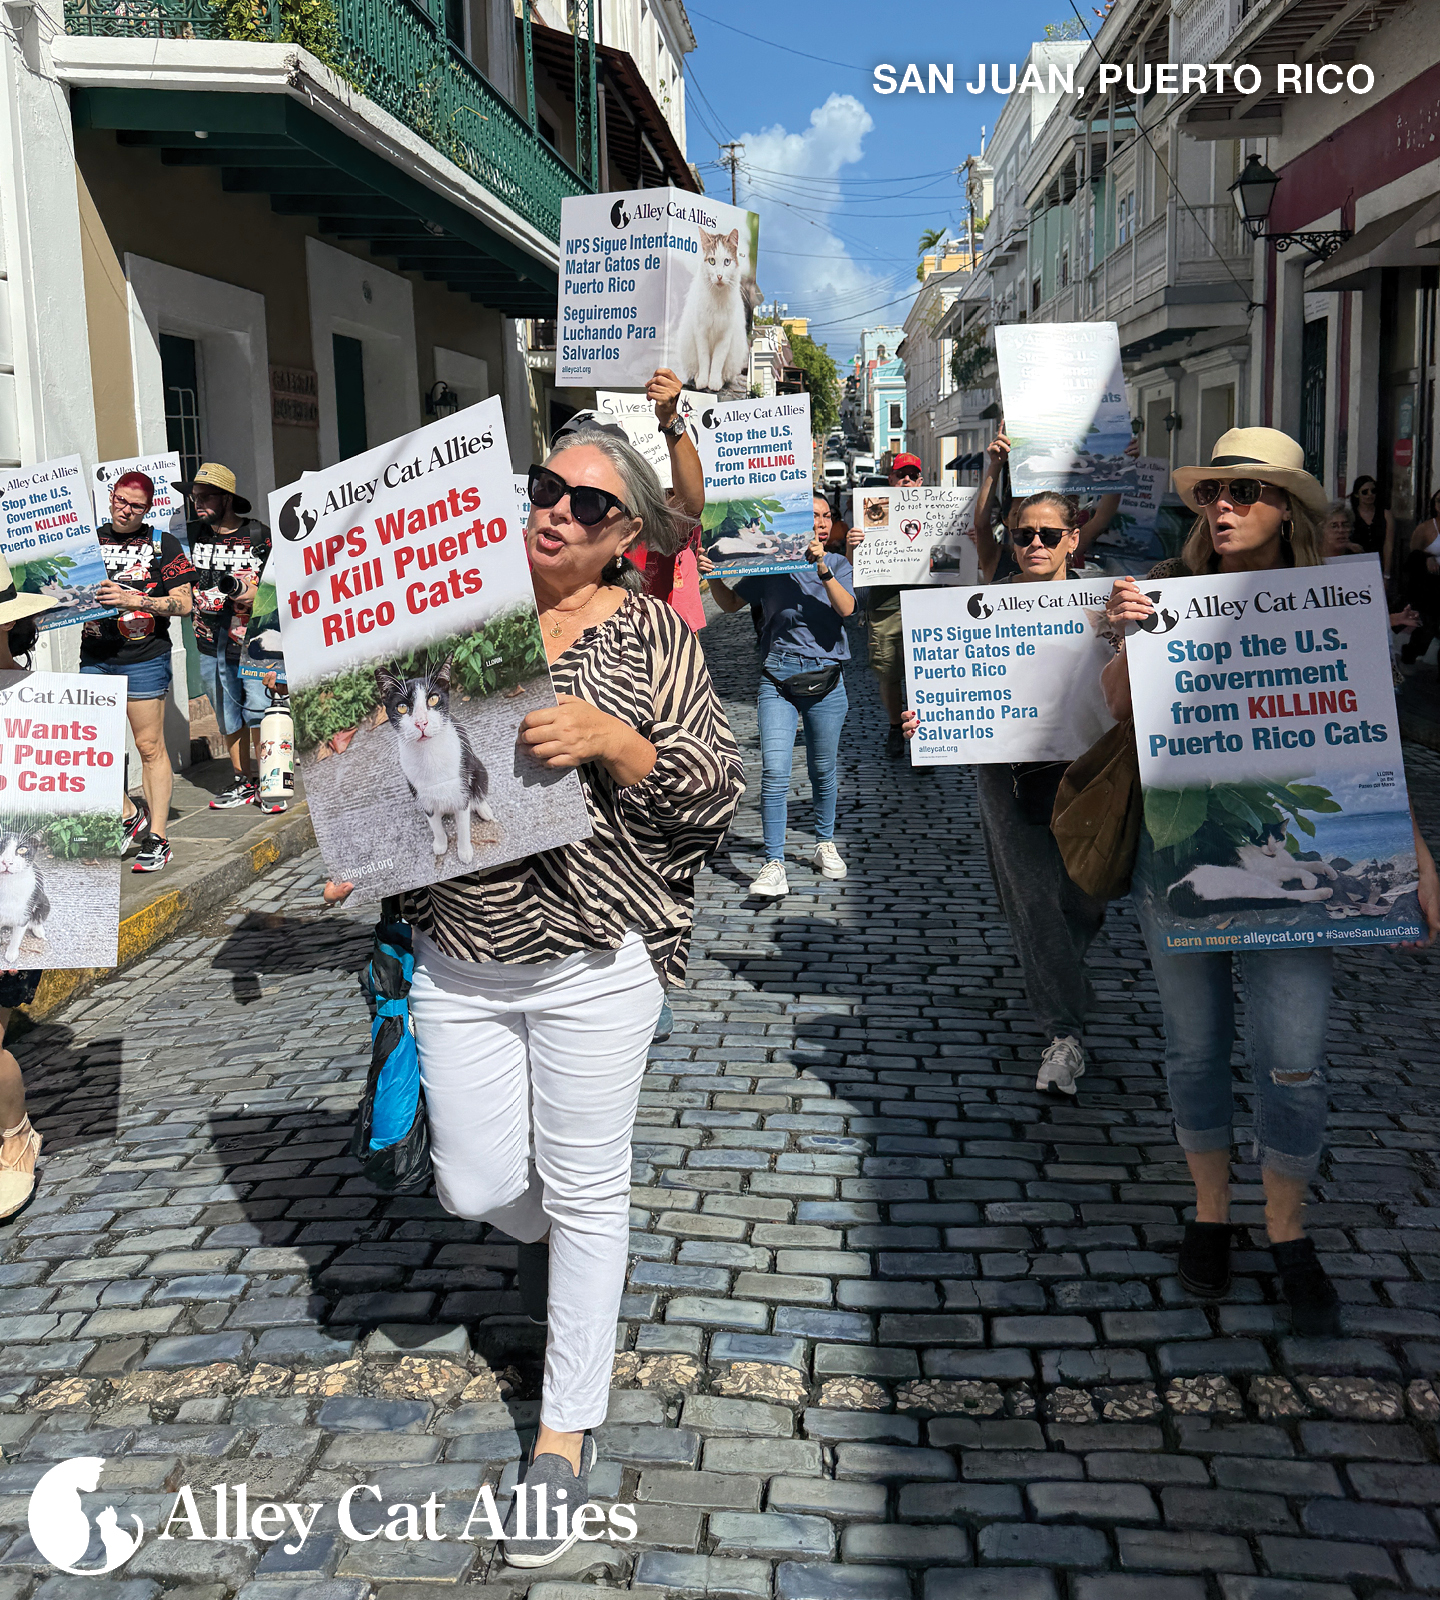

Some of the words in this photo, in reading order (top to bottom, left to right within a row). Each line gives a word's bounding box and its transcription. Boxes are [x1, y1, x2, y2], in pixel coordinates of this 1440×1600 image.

[633, 203, 664, 221] Alley
[666, 201, 687, 221] Cat
[687, 208, 717, 228] Allies
[566, 238, 590, 255] NPS
[592, 236, 627, 255] Sigue
[630, 232, 698, 254] Intentando
[565, 258, 600, 275] Matar
[605, 256, 640, 273] Gatos
[644, 254, 660, 270] de
[565, 279, 604, 295] Puerto
[608, 276, 636, 293] Rico
[563, 305, 638, 324] Seguiremos
[563, 324, 623, 341] Luchando
[627, 323, 656, 340] Para
[562, 345, 620, 361] Salvarlos
[561, 365, 592, 375] alleycat.org
[723, 410, 751, 423] Alley
[753, 408, 773, 419] Cat
[774, 404, 805, 417] Allies
[715, 431, 744, 444] Stop
[746, 428, 767, 440] the
[770, 425, 793, 438] U.S.
[717, 440, 793, 458] Government
[152, 460, 177, 471] Allies
[322, 478, 379, 516] Alley
[383, 457, 424, 489] Cat
[428, 430, 494, 473] Allies
[715, 461, 744, 473] from
[748, 454, 795, 470] KILLING
[7, 478, 31, 492] Alley
[32, 473, 50, 485] Cat
[51, 466, 79, 480] Allies
[704, 474, 745, 488] Puerto
[749, 472, 777, 484] Rico
[780, 468, 807, 481] Cats
[1, 497, 27, 512] Stop
[29, 493, 48, 505] the
[50, 485, 72, 499] U.S.
[894, 502, 906, 512] do
[6, 499, 74, 525] Government
[159, 507, 181, 517] Cats
[6, 525, 34, 539] from
[34, 511, 79, 532] KILLING
[302, 525, 368, 577] NPS
[374, 486, 481, 546] Wants
[0, 537, 36, 554] Puerto
[38, 531, 64, 545] Rico
[65, 524, 92, 538] Cats
[288, 589, 320, 620] to
[330, 556, 384, 604] Kill
[393, 517, 508, 580] Puerto
[738, 567, 770, 575] alleycat.org
[321, 601, 396, 648] Rico
[406, 567, 483, 616] Cats
[997, 596, 1035, 613] Alley
[1038, 594, 1065, 608] Cat
[1067, 592, 1110, 607] Allies
[1184, 595, 1248, 621] Alley
[1254, 590, 1298, 614] Cat
[1301, 585, 1372, 610] Allies
[911, 627, 943, 643] NPS
[946, 626, 992, 644] Sigue
[995, 620, 1084, 639] Intentando
[913, 646, 960, 662] Matar
[965, 643, 1011, 659] Gatos
[1015, 641, 1036, 656] de
[1167, 636, 1232, 665] Stop
[1240, 633, 1287, 658] the
[1295, 627, 1348, 654] U.S.
[241, 667, 258, 677] Learn
[914, 664, 966, 680] Puerto
[971, 662, 1007, 677] Rico
[1175, 659, 1349, 694] Government
[18, 686, 55, 704] Cat
[58, 688, 117, 707] Allies
[915, 688, 1012, 707] Seguiremos
[1170, 700, 1240, 725] from
[1247, 689, 1358, 720] KILLING
[916, 706, 996, 723] Luchando
[1001, 705, 1038, 719] Para
[4, 718, 98, 741] Wants
[918, 725, 994, 741] Salvarlos
[1148, 729, 1243, 758] Puerto
[1252, 725, 1316, 752] Rico
[1324, 719, 1388, 747] Cats
[14, 743, 114, 768] Puerto
[918, 745, 958, 754] alleycat.org
[18, 770, 86, 793] Cats
[341, 858, 394, 881] alleycat.org
[1166, 935, 1202, 948] Learn
[1206, 934, 1242, 946] more:
[1243, 930, 1315, 945] alleycat.org
[1326, 926, 1420, 939] #SaveSanJuanCats
